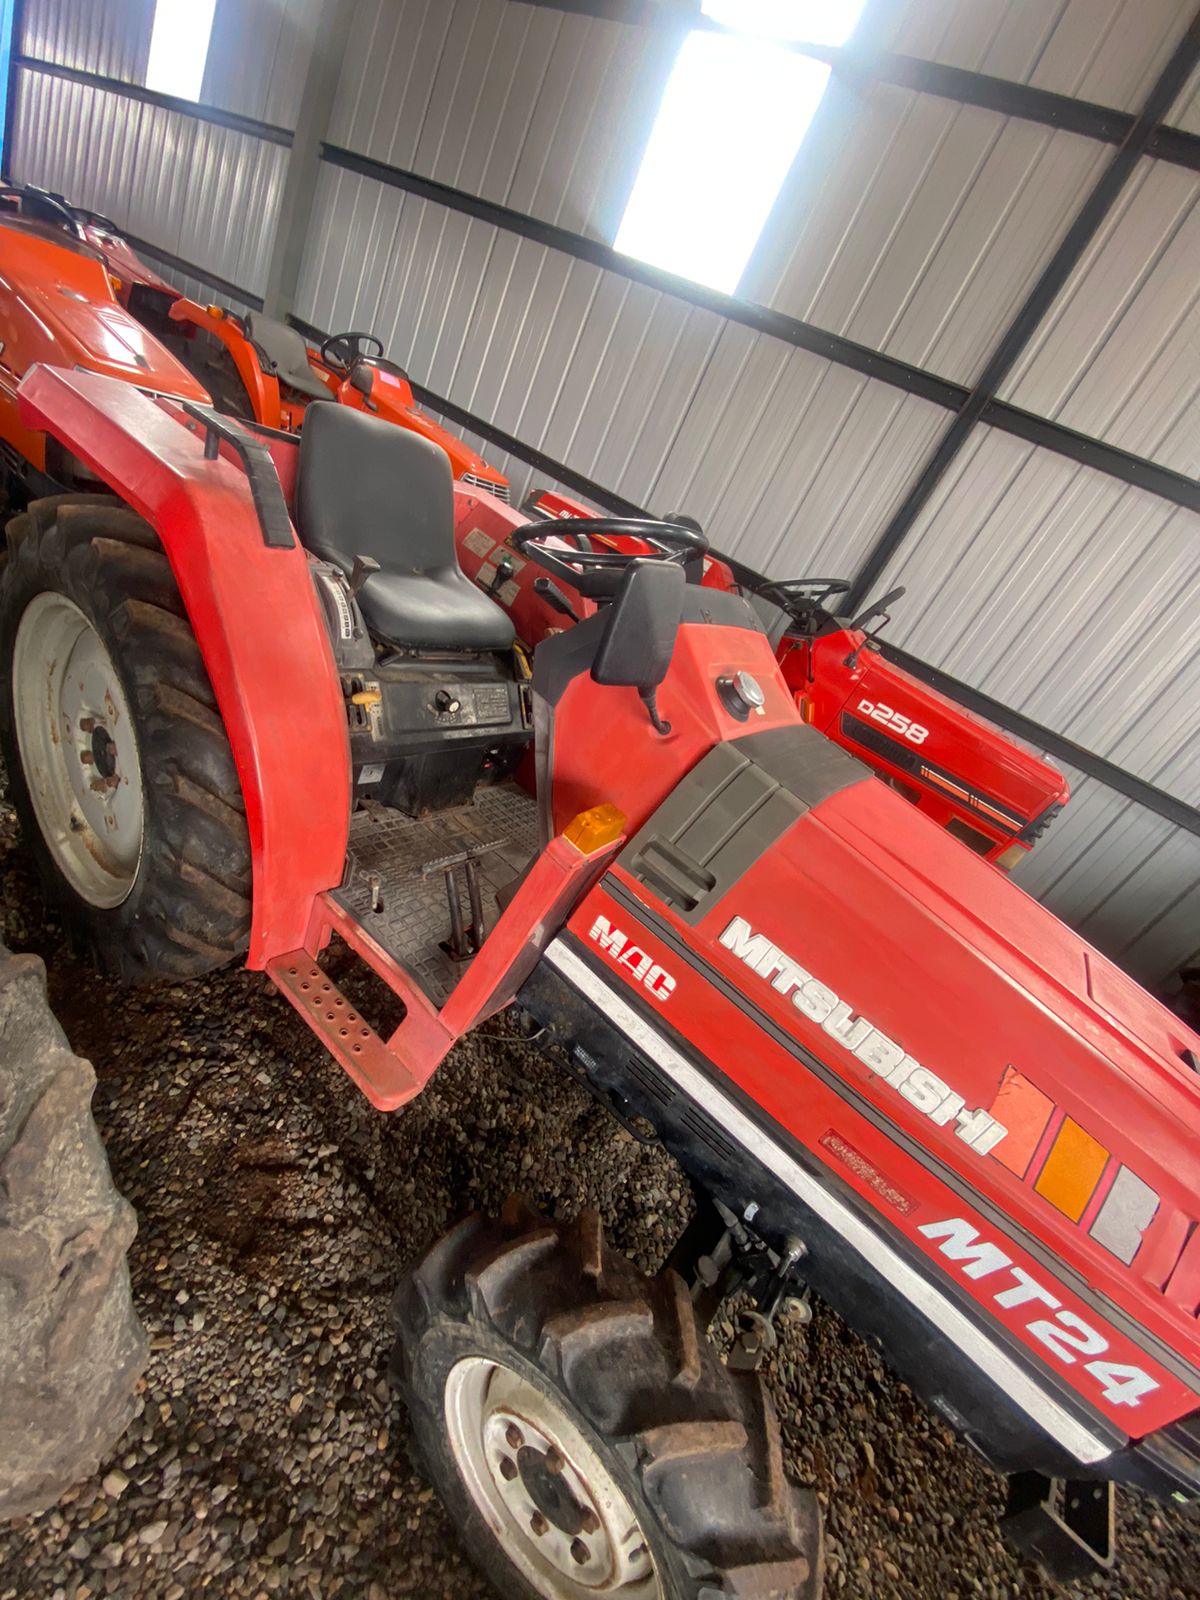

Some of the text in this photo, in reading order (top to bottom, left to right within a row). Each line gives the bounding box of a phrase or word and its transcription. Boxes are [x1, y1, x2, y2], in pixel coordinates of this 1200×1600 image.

[856, 699, 930, 745] D258
[588, 915, 677, 1001] MAC
[719, 915, 1008, 1156] MITSUBISHI
[917, 1218, 1161, 1407] MT24
